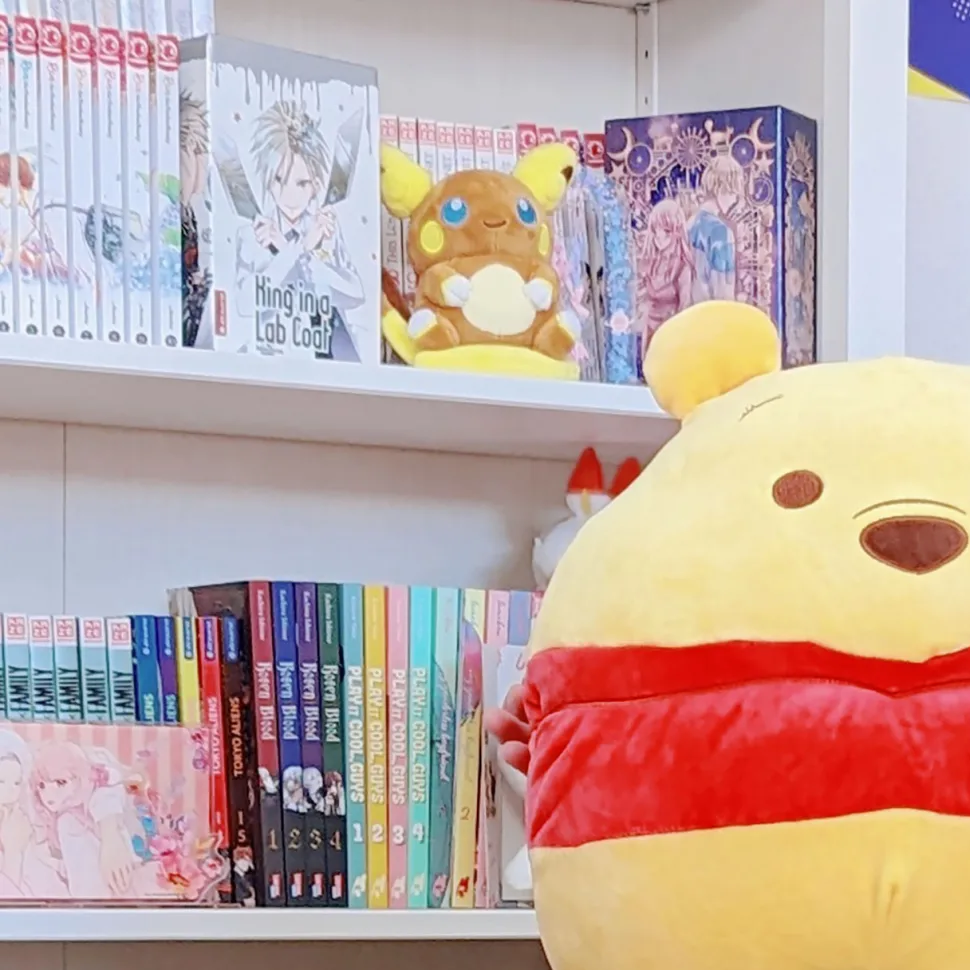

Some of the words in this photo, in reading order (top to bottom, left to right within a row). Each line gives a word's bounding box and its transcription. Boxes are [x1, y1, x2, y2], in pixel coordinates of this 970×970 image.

[255, 275, 293, 318] King
[299, 282, 314, 314] in
[320, 294, 330, 316] a
[255, 310, 286, 345] Lab
[292, 316, 331, 351] Coat
[254, 661, 273, 699] Rosen
[276, 661, 295, 699] Rosen
[300, 662, 318, 700] Rosen
[321, 664, 339, 702] Rosen
[348, 666, 362, 706] PLAY
[368, 668, 382, 707] PLAY
[392, 669, 405, 708] PLAY
[412, 668, 425, 707] PLAY
[229, 696, 241, 737] ALIENS
[259, 705, 277, 740] Blood
[281, 705, 299, 740] Blood
[303, 706, 320, 741] Blood
[324, 708, 341, 743] Blood
[231, 737, 244, 777] TOKYO
[350, 763, 364, 803] GUYS
[369, 764, 384, 804] GUYS
[391, 766, 406, 805] GUYS
[412, 764, 425, 803] GUYS
[269, 828, 278, 850] 1
[330, 830, 342, 850] 4
[352, 823, 363, 842] 1
[371, 823, 384, 843] 2
[392, 825, 404, 845] 3
[412, 822, 425, 842] 4
